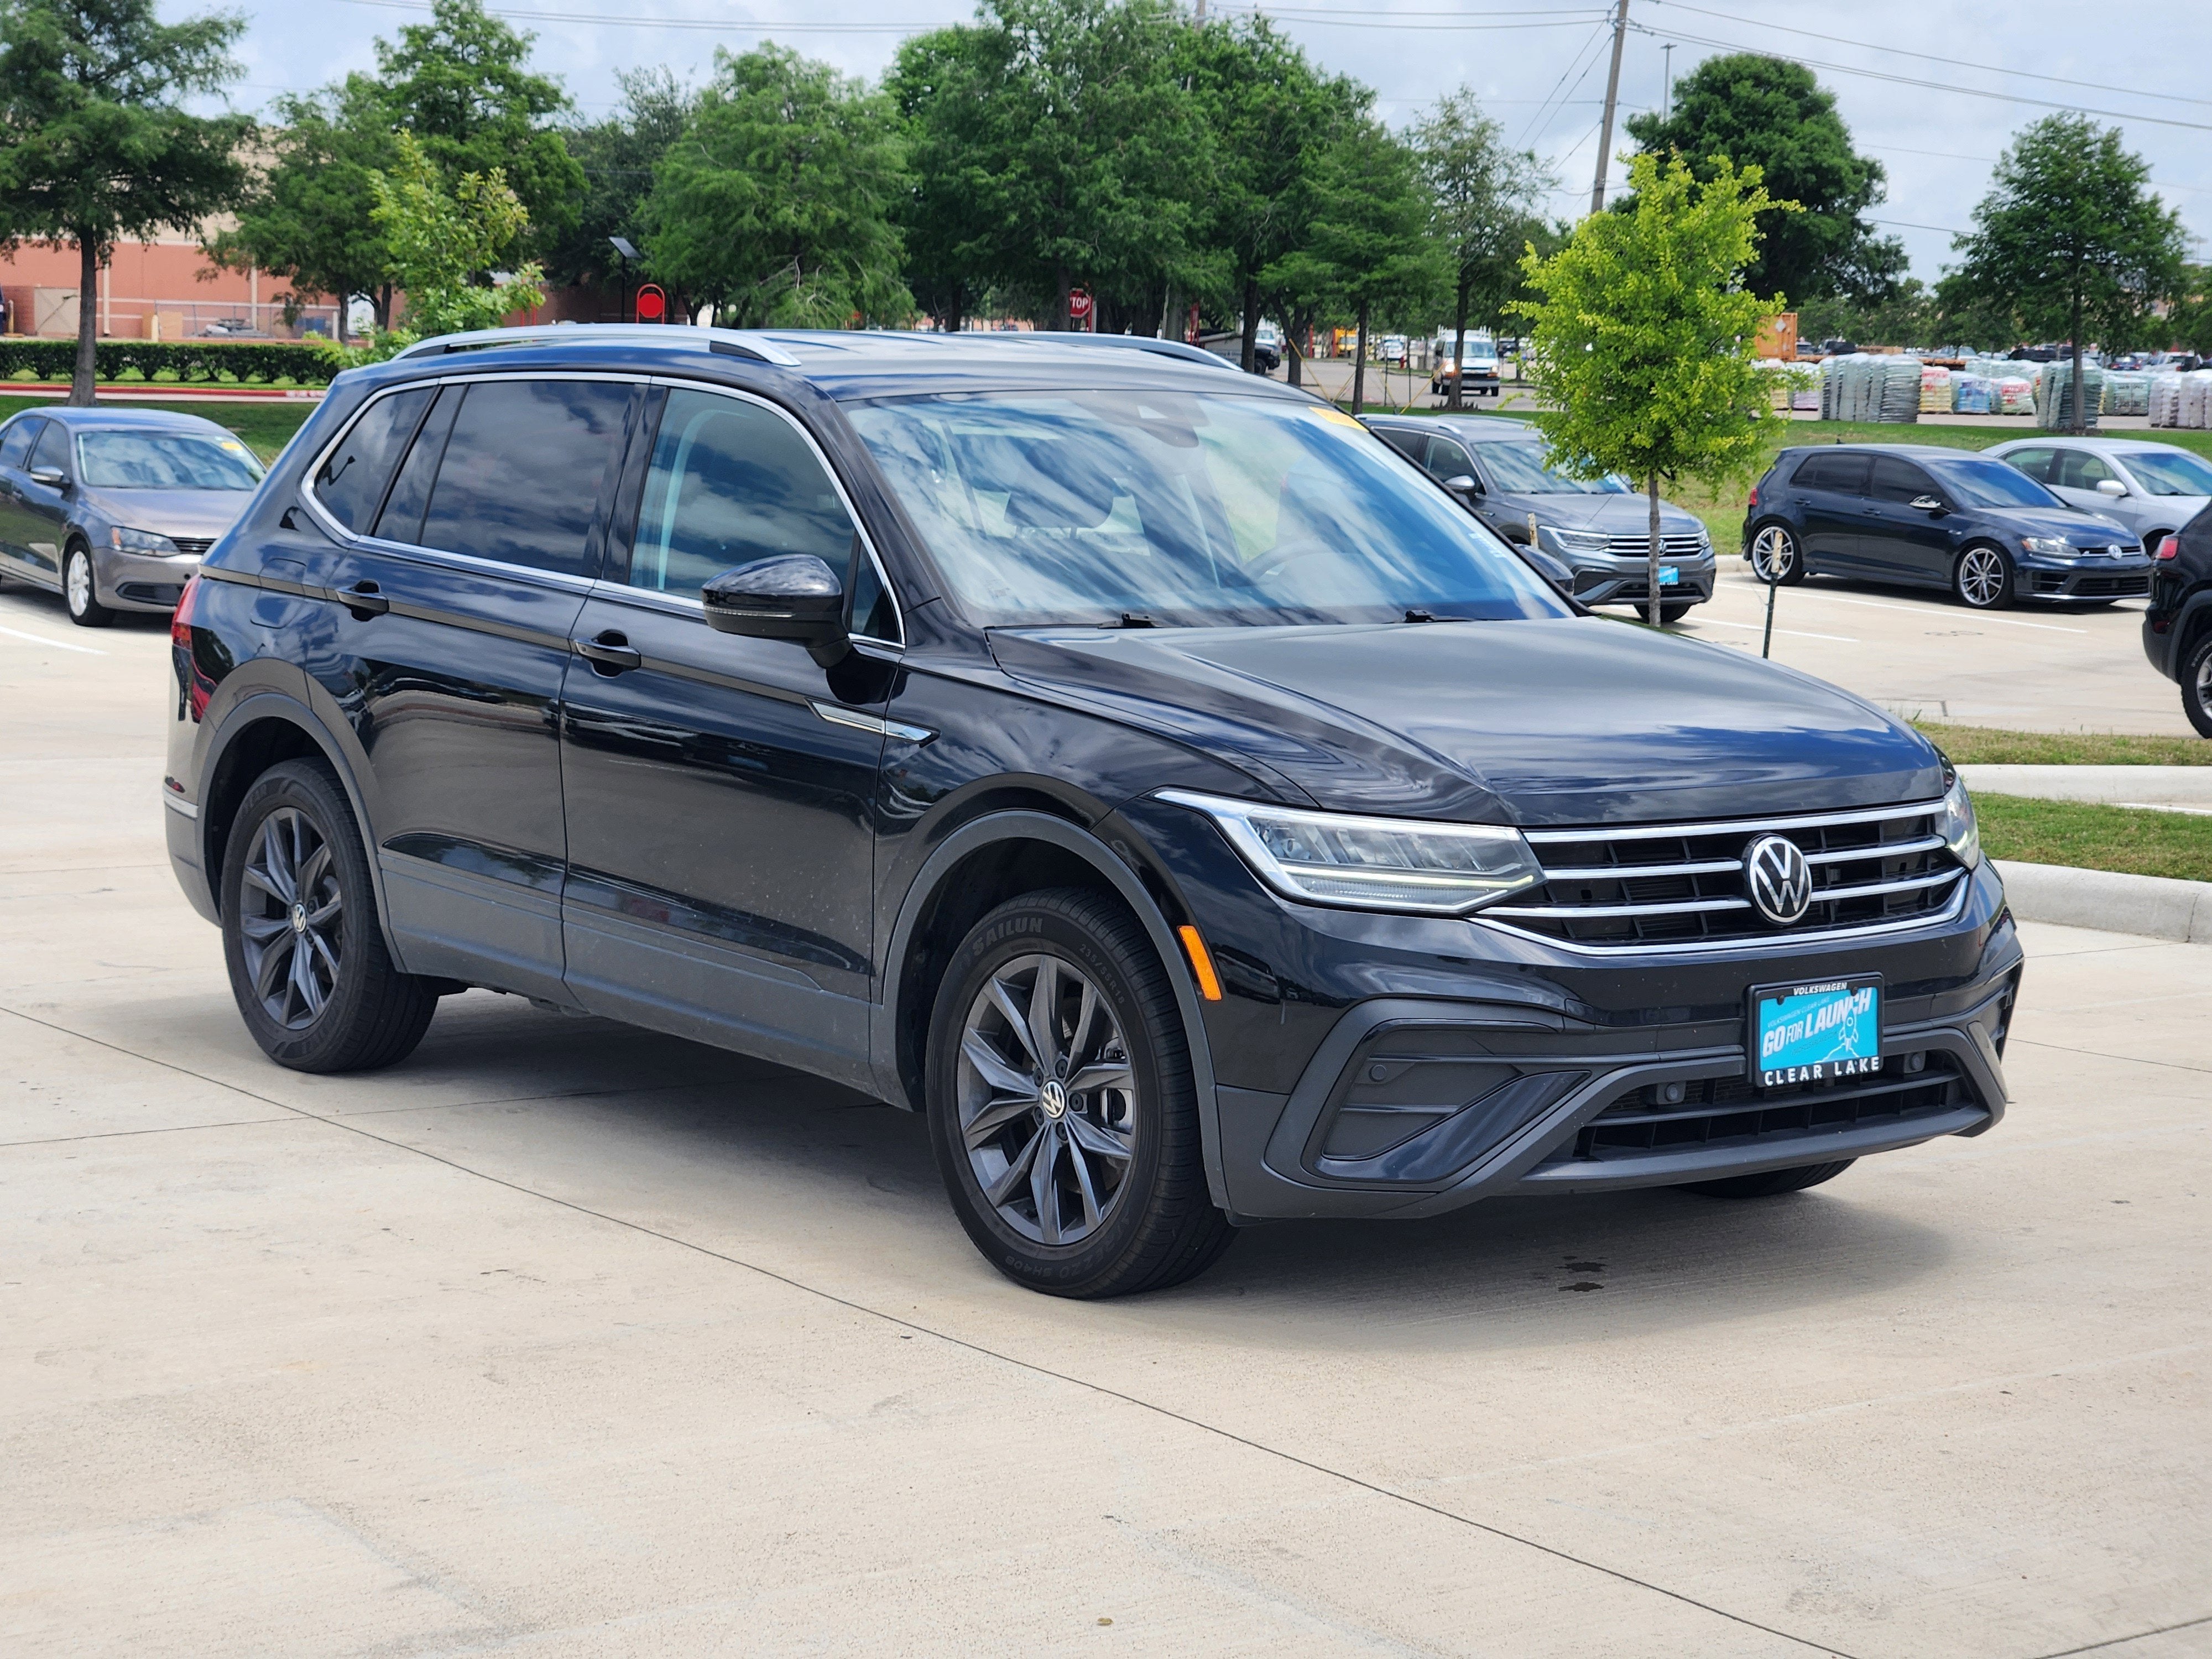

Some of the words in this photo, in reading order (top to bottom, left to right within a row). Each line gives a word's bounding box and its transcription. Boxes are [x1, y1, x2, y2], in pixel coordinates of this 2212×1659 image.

[1070, 296, 1089, 309] TOP
[1749, 836, 1812, 923] VW
[972, 917, 1043, 956] SAILUN
[1793, 982, 1848, 995] VOLKSWAGEN
[1762, 1025, 1786, 1058] GO
[1786, 1020, 1804, 1045] FOR
[1804, 987, 1872, 1039] LAUNCH
[1765, 1065, 1823, 1087] CLEAR
[1834, 1056, 1880, 1076] LAKE
